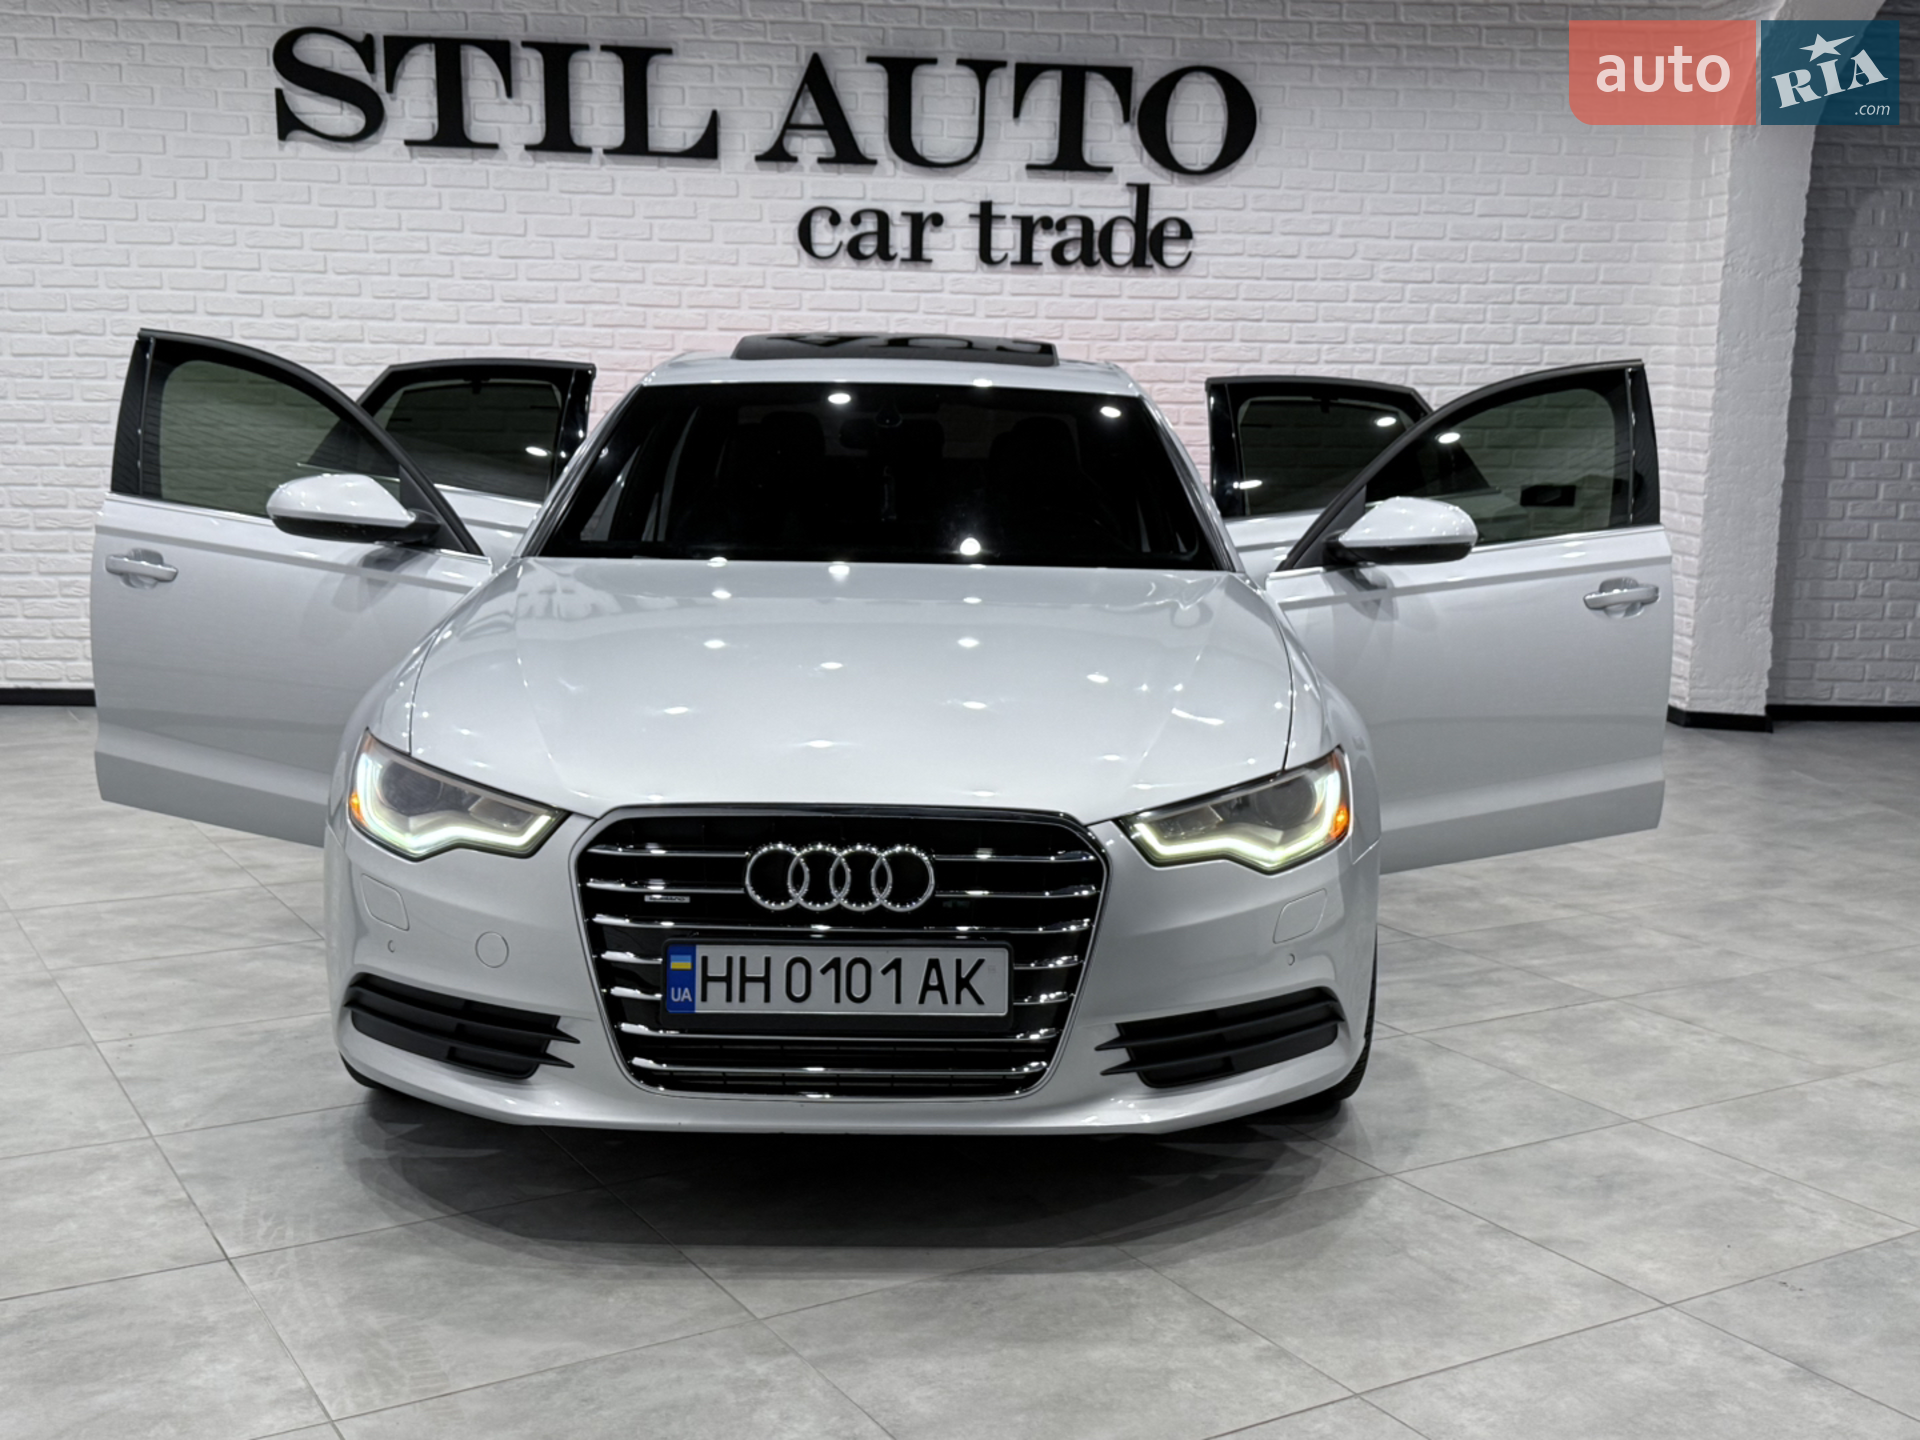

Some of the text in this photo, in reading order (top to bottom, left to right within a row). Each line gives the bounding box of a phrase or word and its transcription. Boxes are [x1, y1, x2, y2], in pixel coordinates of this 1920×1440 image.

[272, 26, 1258, 176] STIL AUTO
[798, 183, 1194, 269] car trade
[671, 987, 692, 1003] UA
